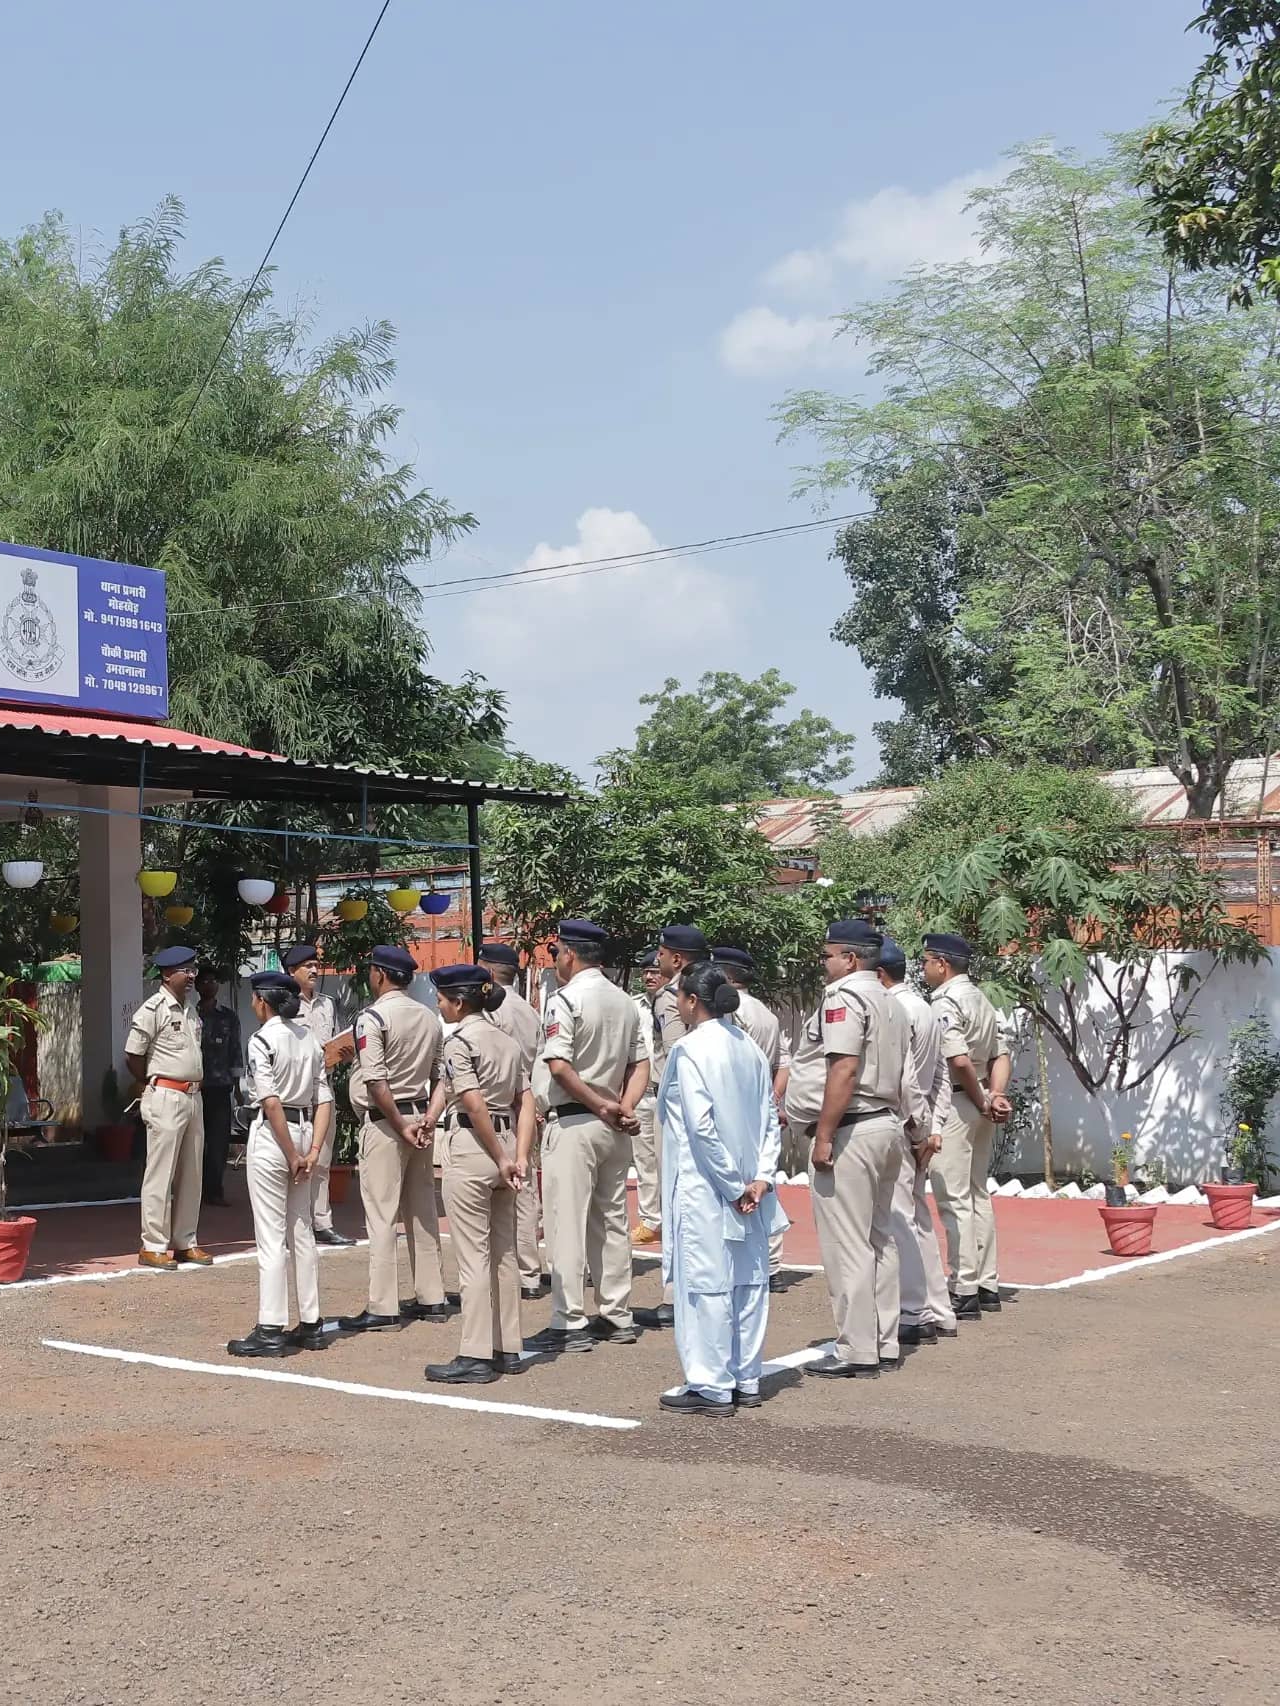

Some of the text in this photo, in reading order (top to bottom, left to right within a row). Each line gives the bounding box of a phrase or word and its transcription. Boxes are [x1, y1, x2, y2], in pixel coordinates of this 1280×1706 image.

[122, 585, 146, 599] प्रभारी
[83, 609, 163, 633] मो. 9479991643
[124, 649, 147, 662] प्रभारी
[105, 663, 146, 678] उमरानाला
[84, 674, 99, 688] मो.
